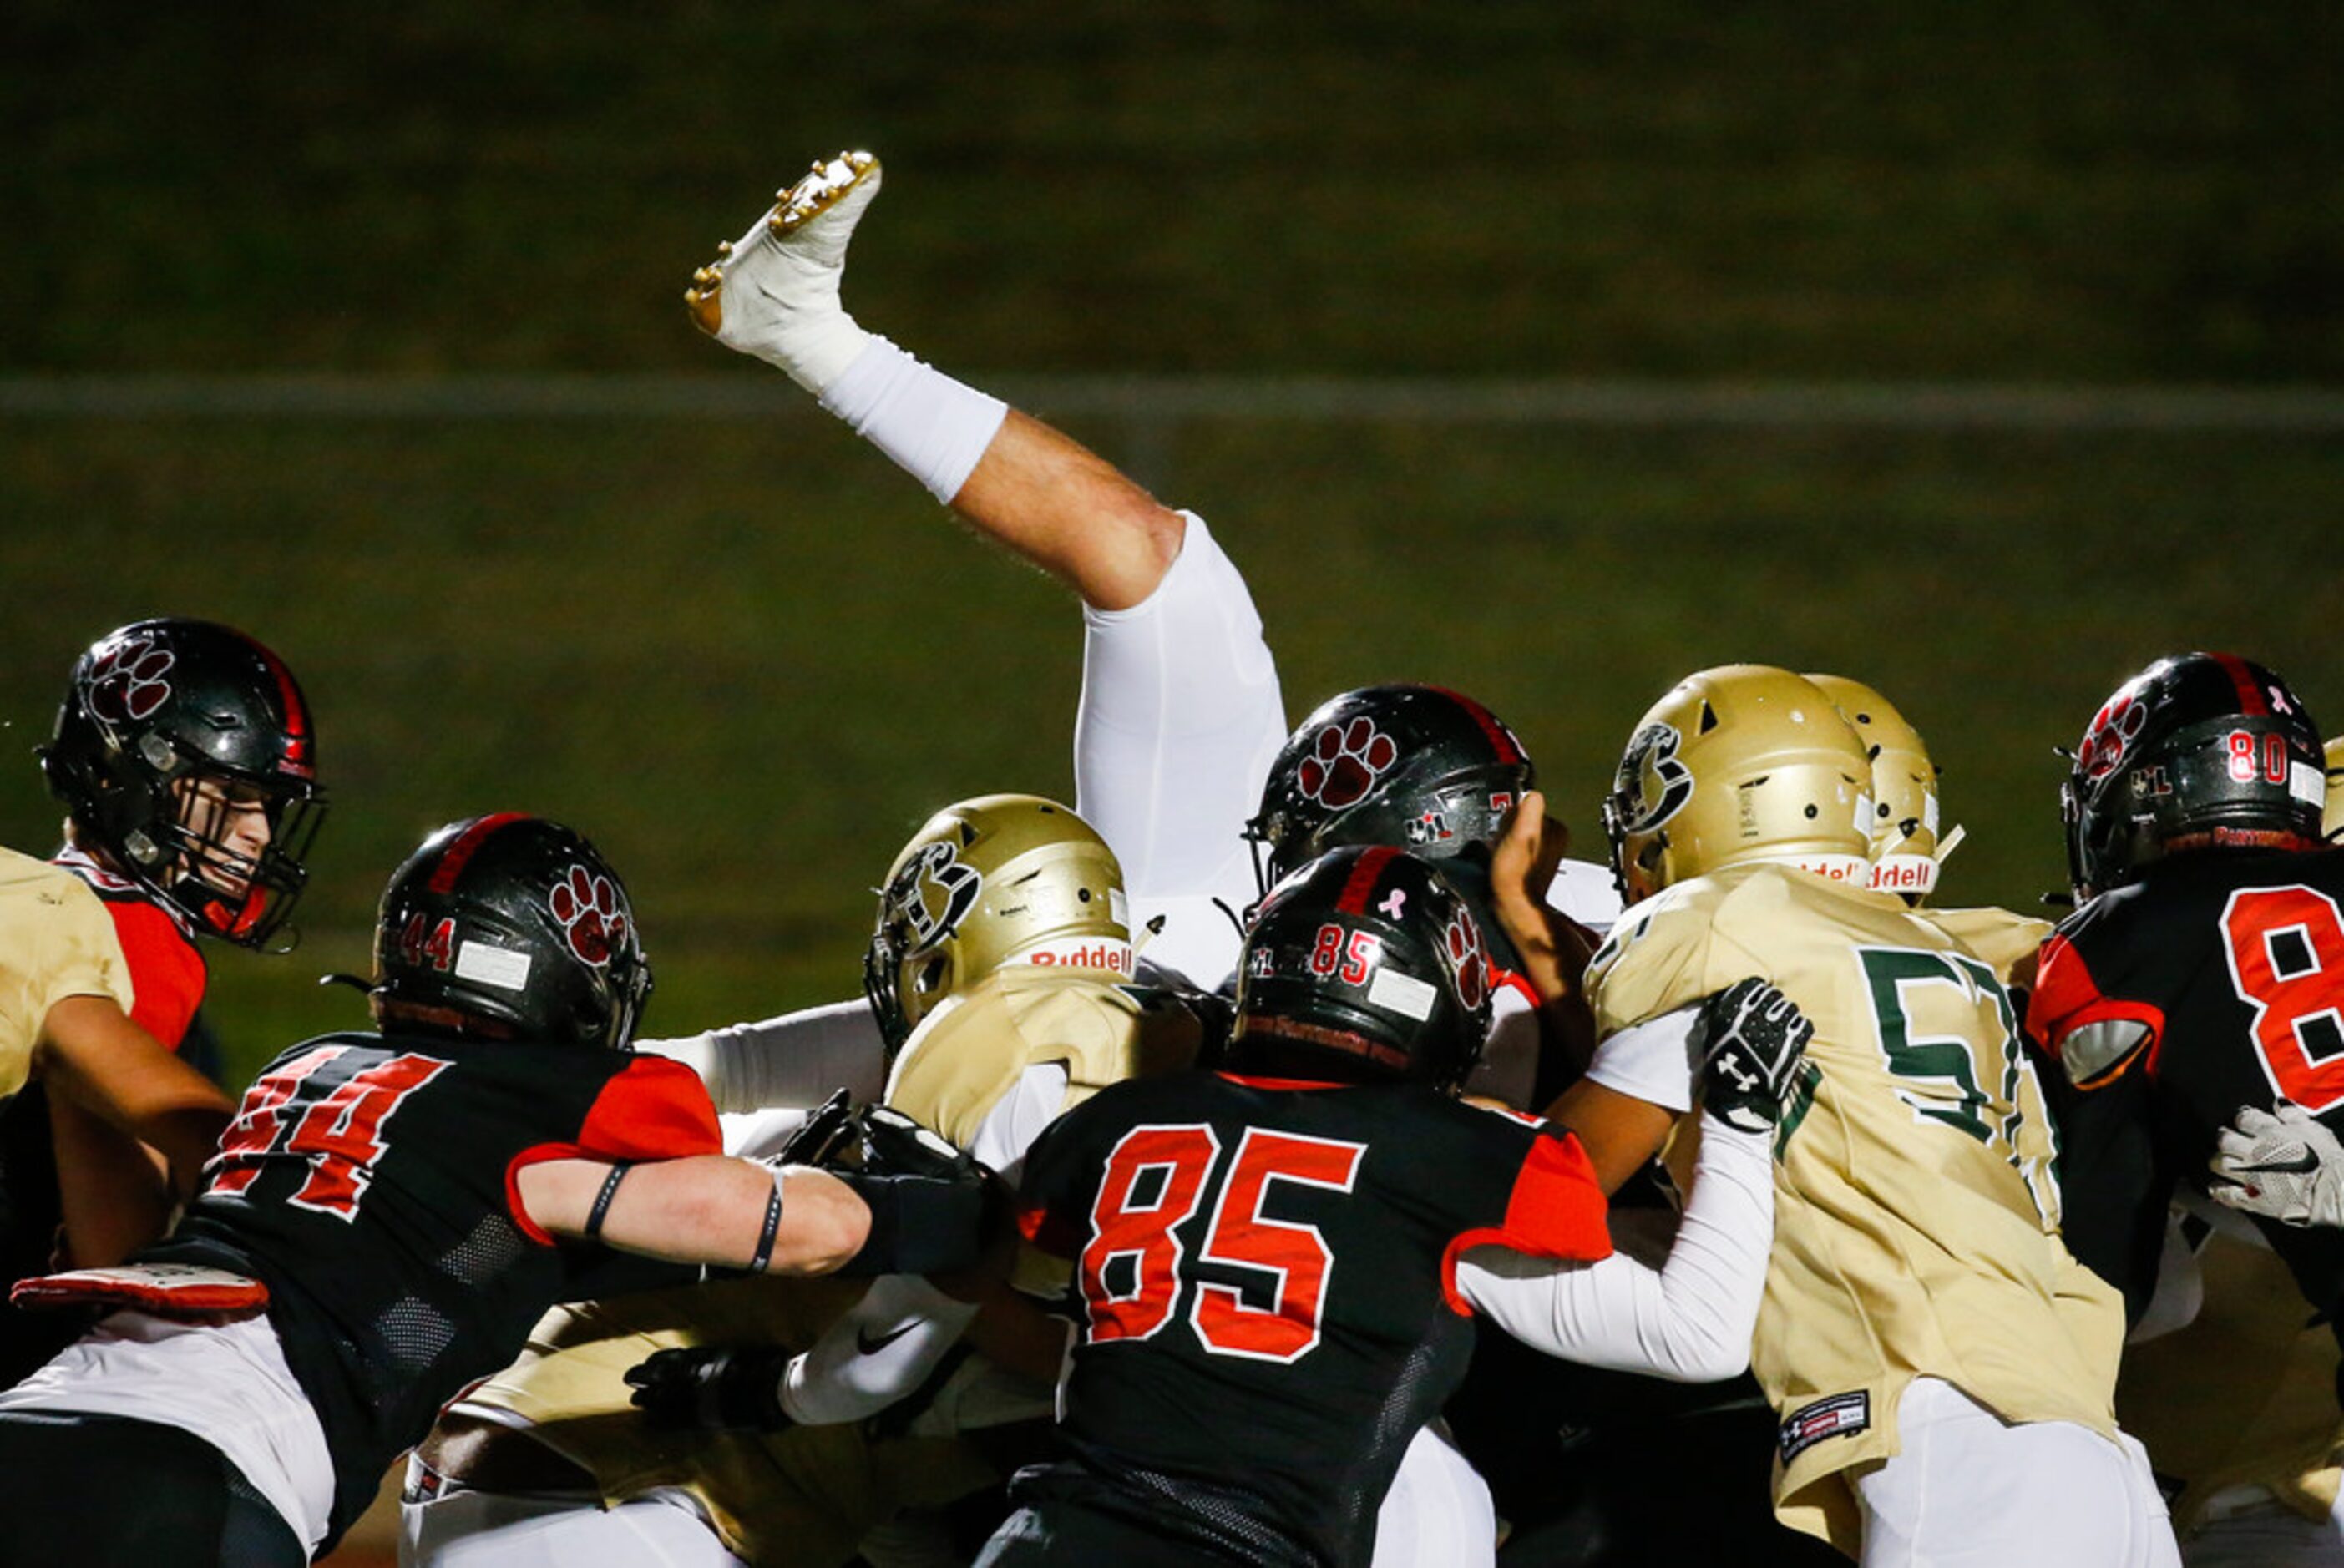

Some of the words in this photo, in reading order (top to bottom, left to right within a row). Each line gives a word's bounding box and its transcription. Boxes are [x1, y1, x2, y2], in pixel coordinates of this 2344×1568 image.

[2226, 728, 2287, 785] 80
[402, 911, 457, 971] 44
[1311, 923, 1381, 987] 85
[200, 1043, 458, 1226] 44
[1078, 1123, 1369, 1364] 85
